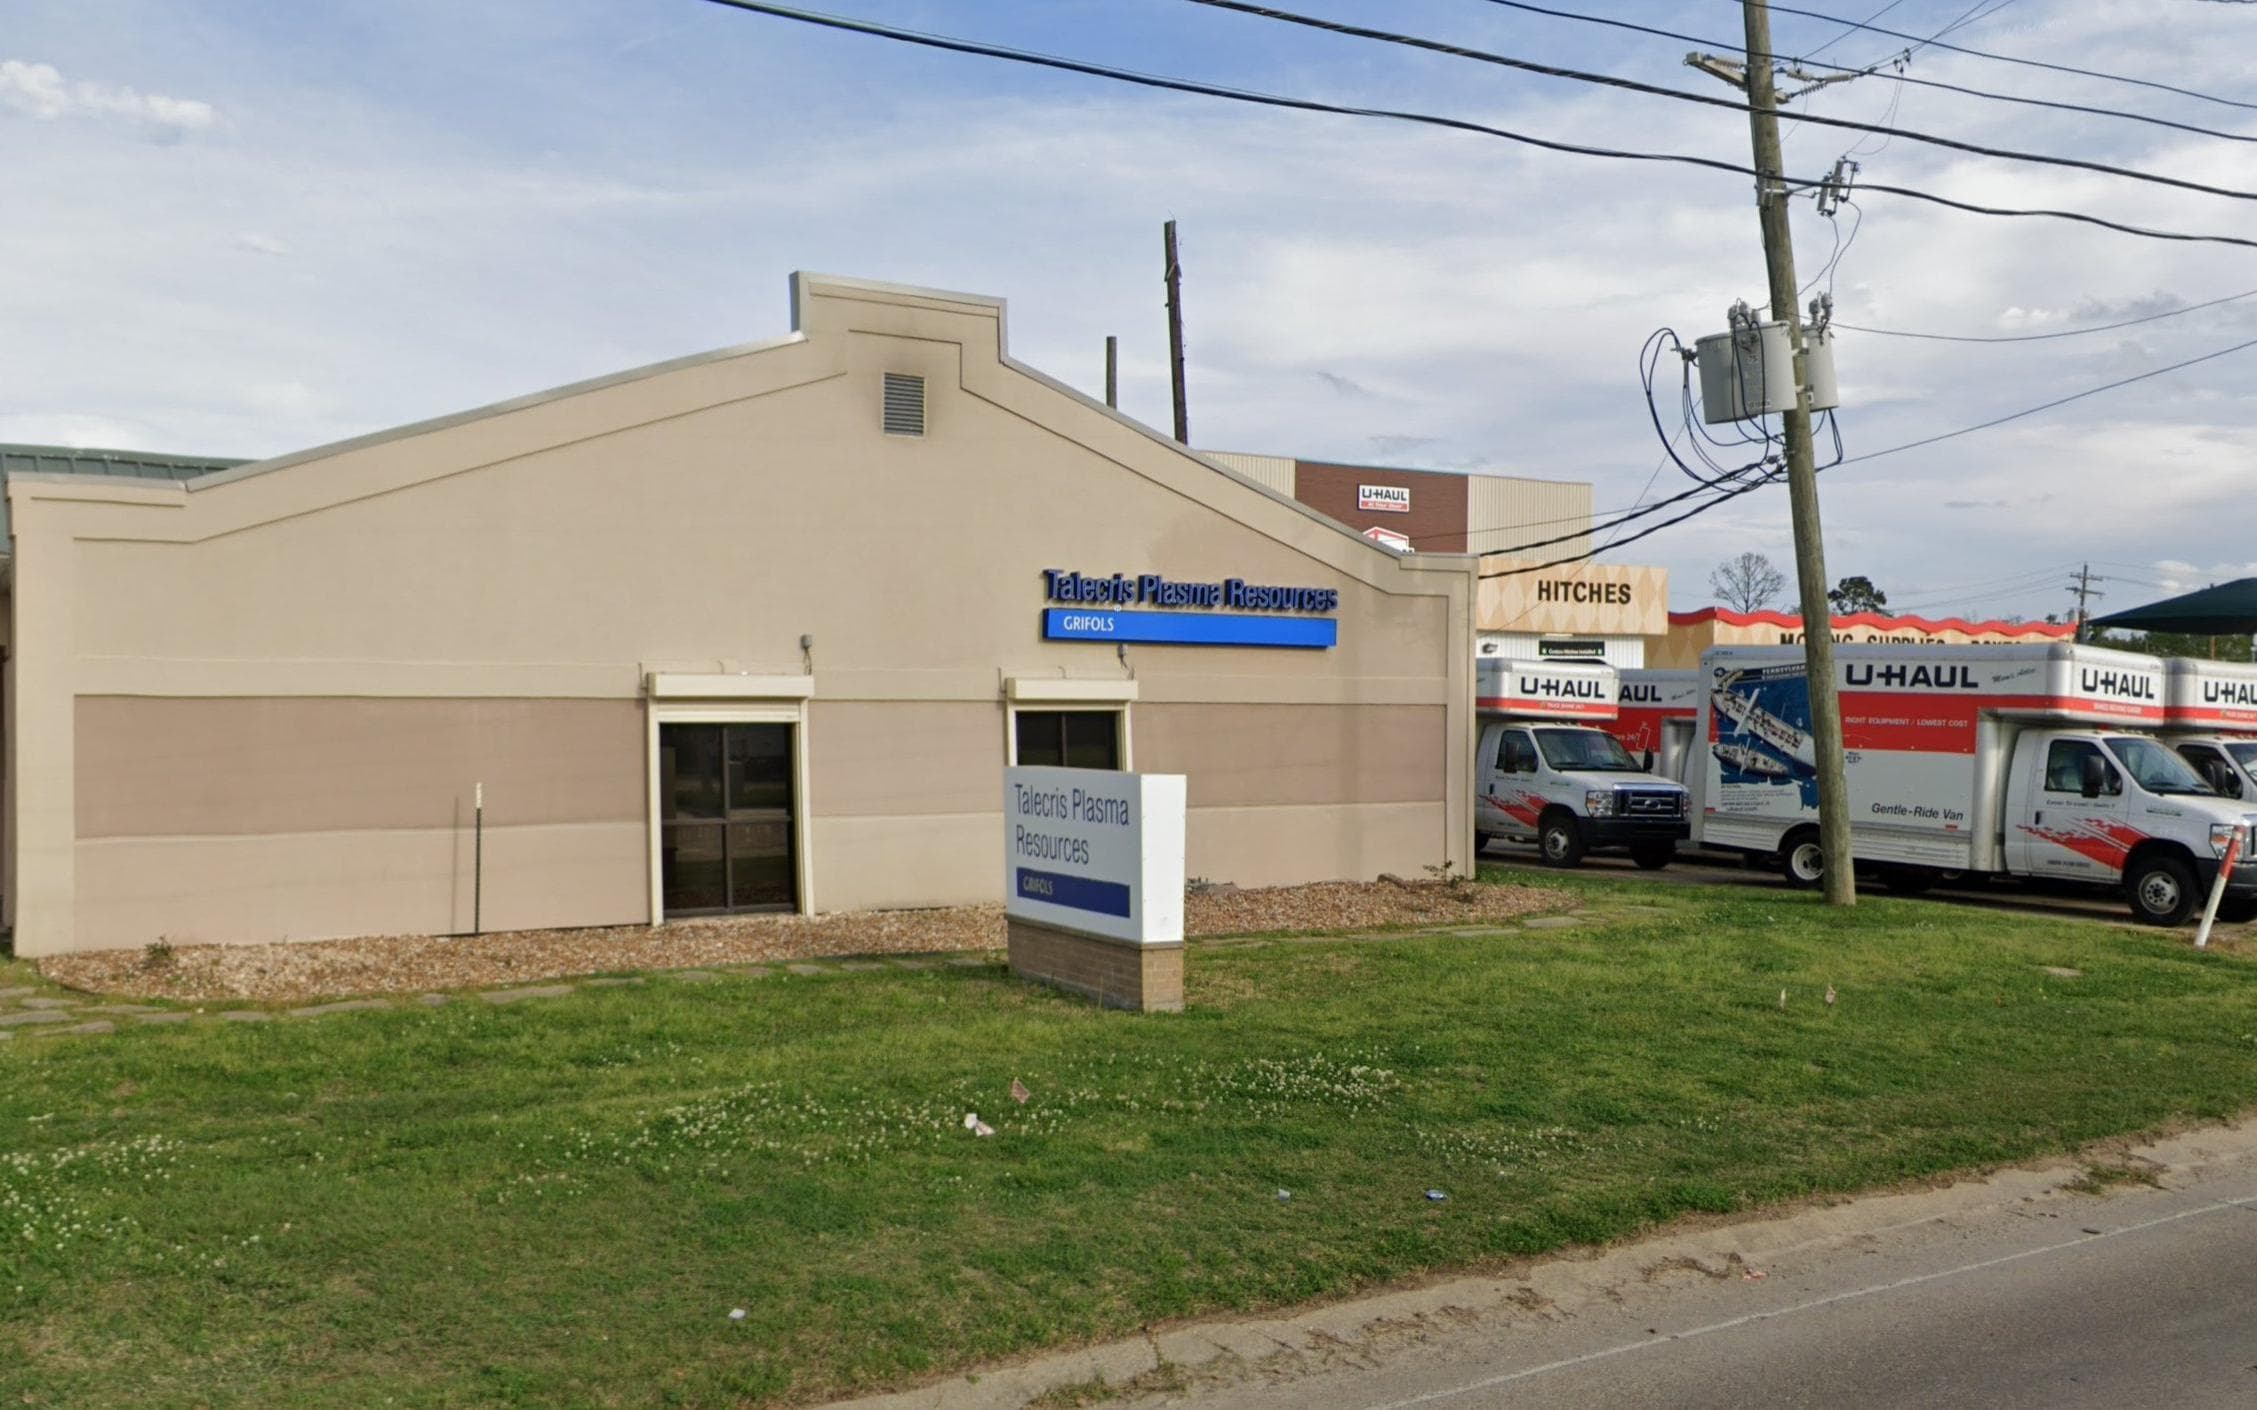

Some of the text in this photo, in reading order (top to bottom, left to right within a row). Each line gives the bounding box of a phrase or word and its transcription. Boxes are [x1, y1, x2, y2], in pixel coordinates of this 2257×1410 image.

[1362, 488, 1407, 501] U-HAUL
[1043, 569, 1338, 611] Talecris Plasma Resources
[1538, 580, 1631, 605] HITCHES
[1064, 616, 1114, 632] GRIFOLS
[1846, 664, 1979, 688] U-HAUL
[2082, 668, 2154, 699] U-HAUL
[1521, 677, 1605, 698] U-HAUL
[1845, 716, 1866, 724] RIGHT
[1868, 717, 1909, 726] EQUIPMENT
[1917, 719, 1946, 727] LOWEST
[1015, 784, 1129, 826] Talecris Plasma
[1872, 803, 1964, 821] Gentle-Ride Van
[1016, 824, 1089, 865] Resources
[1023, 876, 1053, 895] GRIFOLS
